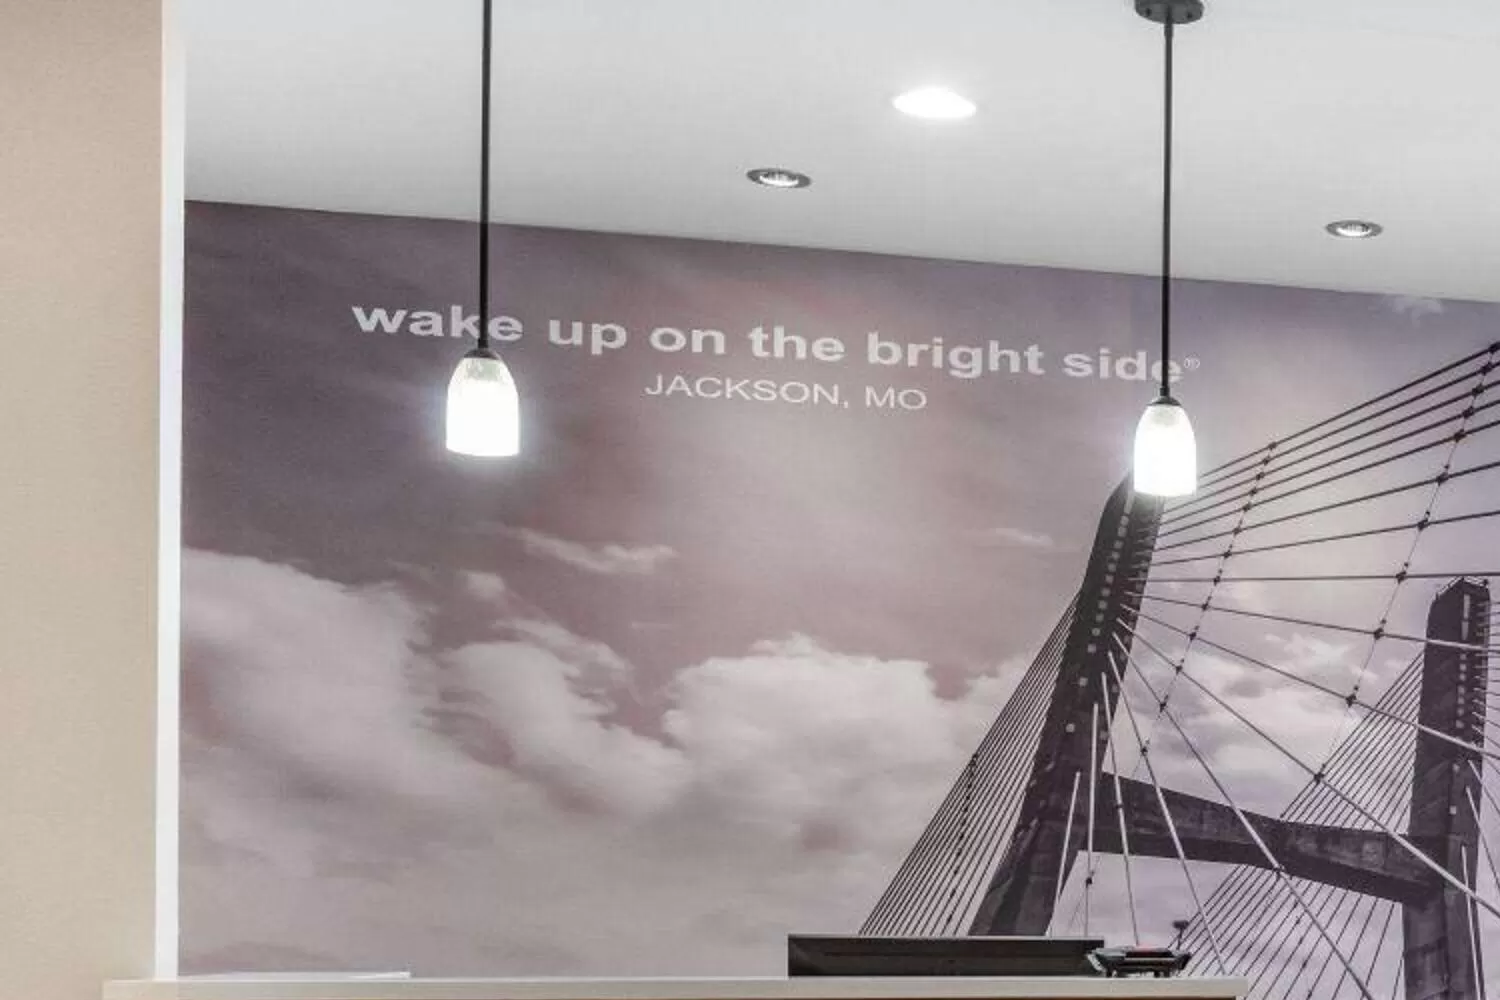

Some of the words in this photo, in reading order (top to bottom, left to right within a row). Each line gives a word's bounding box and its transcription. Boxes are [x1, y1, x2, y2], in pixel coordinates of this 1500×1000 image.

[353, 305, 523, 341] wake
[549, 319, 626, 355] up
[649, 326, 725, 355] on
[749, 325, 845, 361] the
[868, 331, 1045, 379] bright
[645, 374, 848, 408] JACKSON,
[865, 385, 928, 410] MO
